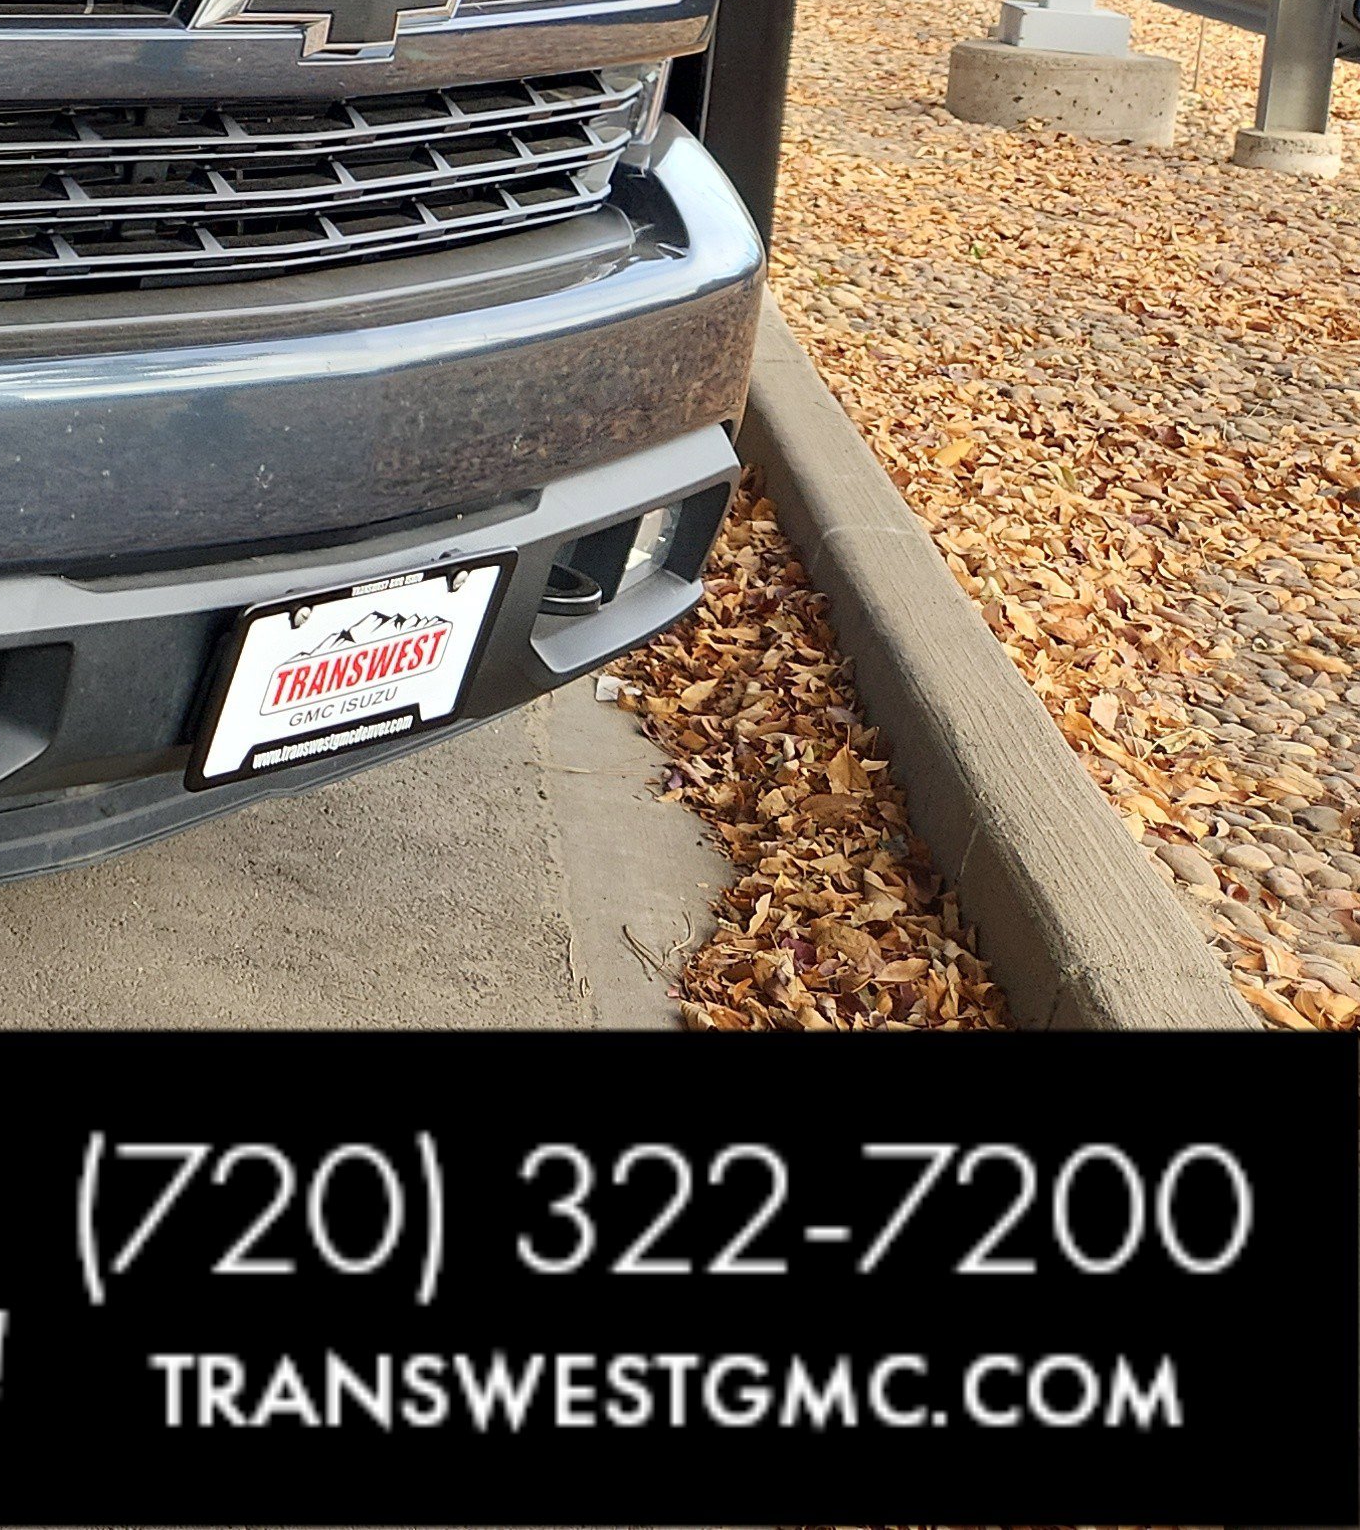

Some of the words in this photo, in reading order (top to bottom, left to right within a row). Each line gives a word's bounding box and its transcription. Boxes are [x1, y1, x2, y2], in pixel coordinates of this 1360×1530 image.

[271, 628, 448, 707] TRANSWEST
[288, 700, 334, 727] GMC
[340, 685, 399, 716] ISUZU
